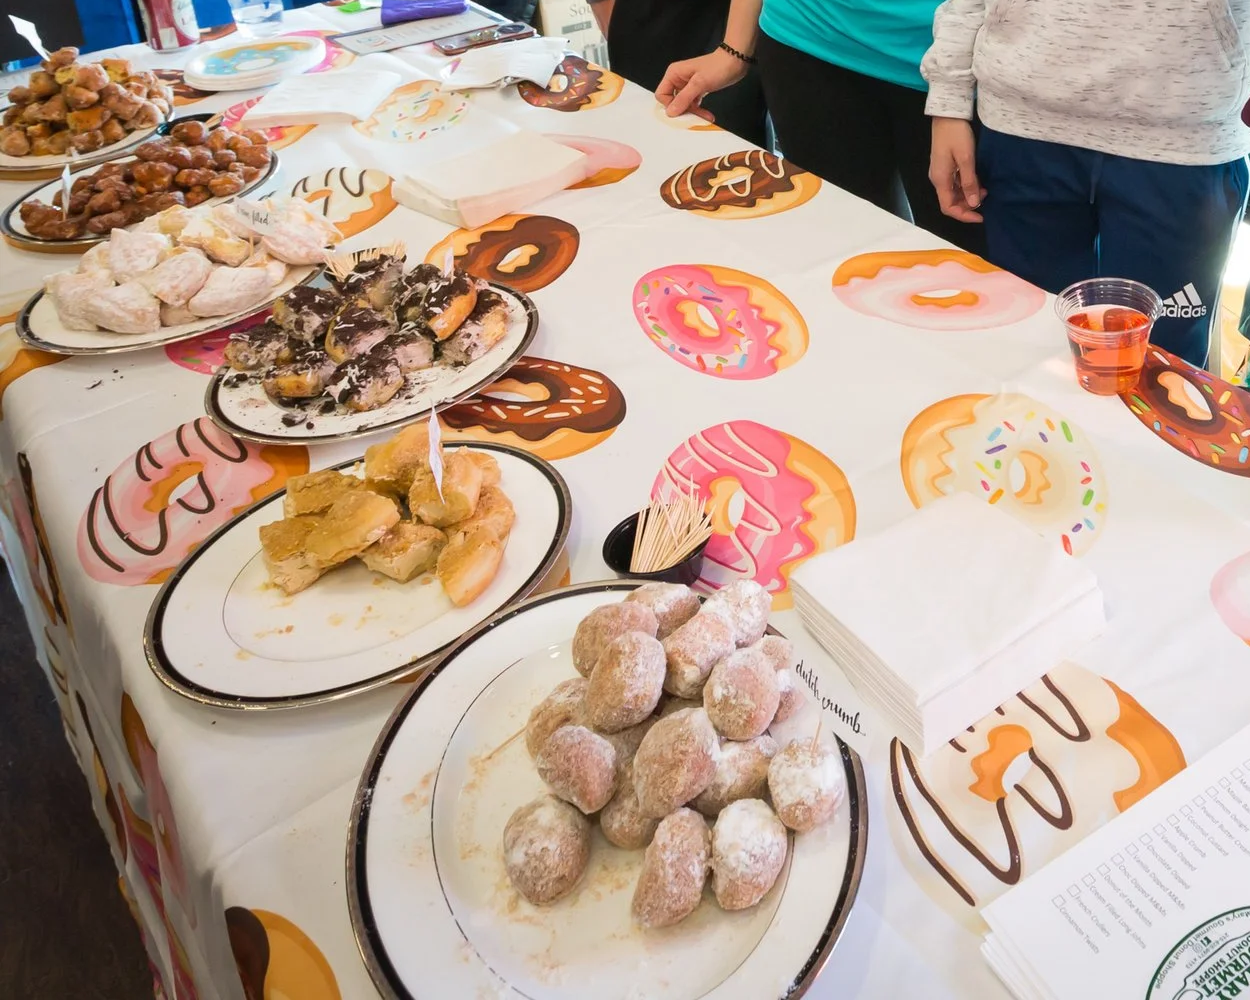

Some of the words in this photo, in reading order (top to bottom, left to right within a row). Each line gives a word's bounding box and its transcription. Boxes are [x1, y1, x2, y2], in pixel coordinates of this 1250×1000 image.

[1160, 305, 1207, 319] adidas
[795, 659, 822, 701] dutch
[820, 696, 862, 736] crumb
[1225, 787, 1243, 804] Maple
[1187, 814, 1210, 838] Coconut
[1200, 805, 1220, 825] Peanut
[1213, 796, 1231, 815] Lemon
[1229, 813, 1250, 834] Delight
[1160, 834, 1179, 853] Vanilla
[1176, 851, 1197, 873] Dipped
[1173, 824, 1191, 842] Apple
[1188, 839, 1207, 858] Crumb
[1118, 863, 1133, 879] Choc
[1130, 877, 1151, 899] Dipped
[1133, 854, 1151, 873] Vanilla
[1148, 871, 1169, 893] Dipped
[1146, 844, 1173, 872] Chocolate
[1170, 869, 1191, 891] Dipped
[1074, 895, 1094, 916] French
[1089, 884, 1108, 905] Cream
[1105, 902, 1121, 920] Filled
[1118, 917, 1133, 934] Long
[1103, 873, 1121, 892] Donut
[1125, 897, 1137, 909] the
[1134, 906, 1154, 928] Month
[1059, 905, 1086, 937] Cinnamon
[1083, 934, 1101, 955] Twists
[1191, 919, 1224, 943] Gourmet
[1172, 937, 1195, 961] Donut
[1153, 958, 1175, 990] Shoppe
[1191, 956, 1226, 988] SHOPPE
